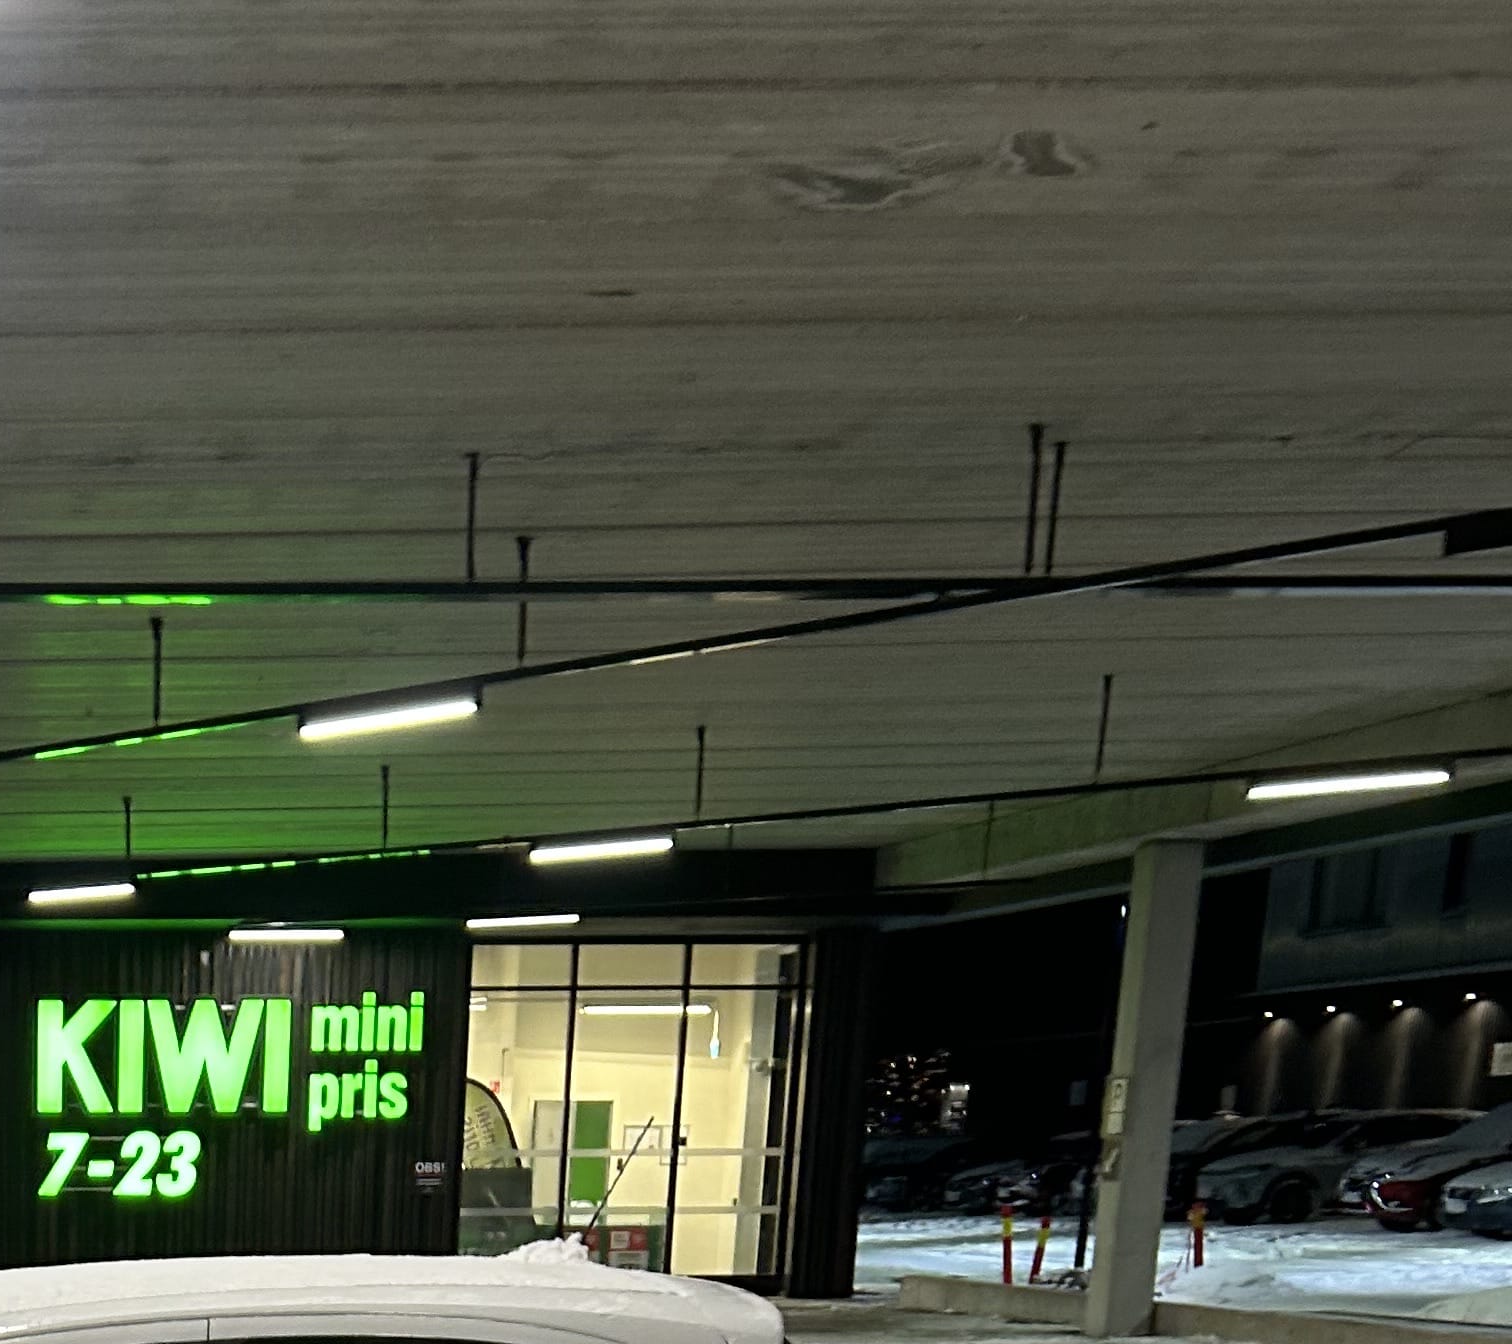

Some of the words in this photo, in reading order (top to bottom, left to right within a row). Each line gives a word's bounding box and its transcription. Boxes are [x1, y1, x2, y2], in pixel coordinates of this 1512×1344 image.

[36, 998, 292, 1114] KIWI
[310, 991, 425, 1053] mini
[307, 1058, 408, 1132] pris
[37, 1130, 201, 1198] 7-23
[415, 1161, 445, 1174] OBS!
